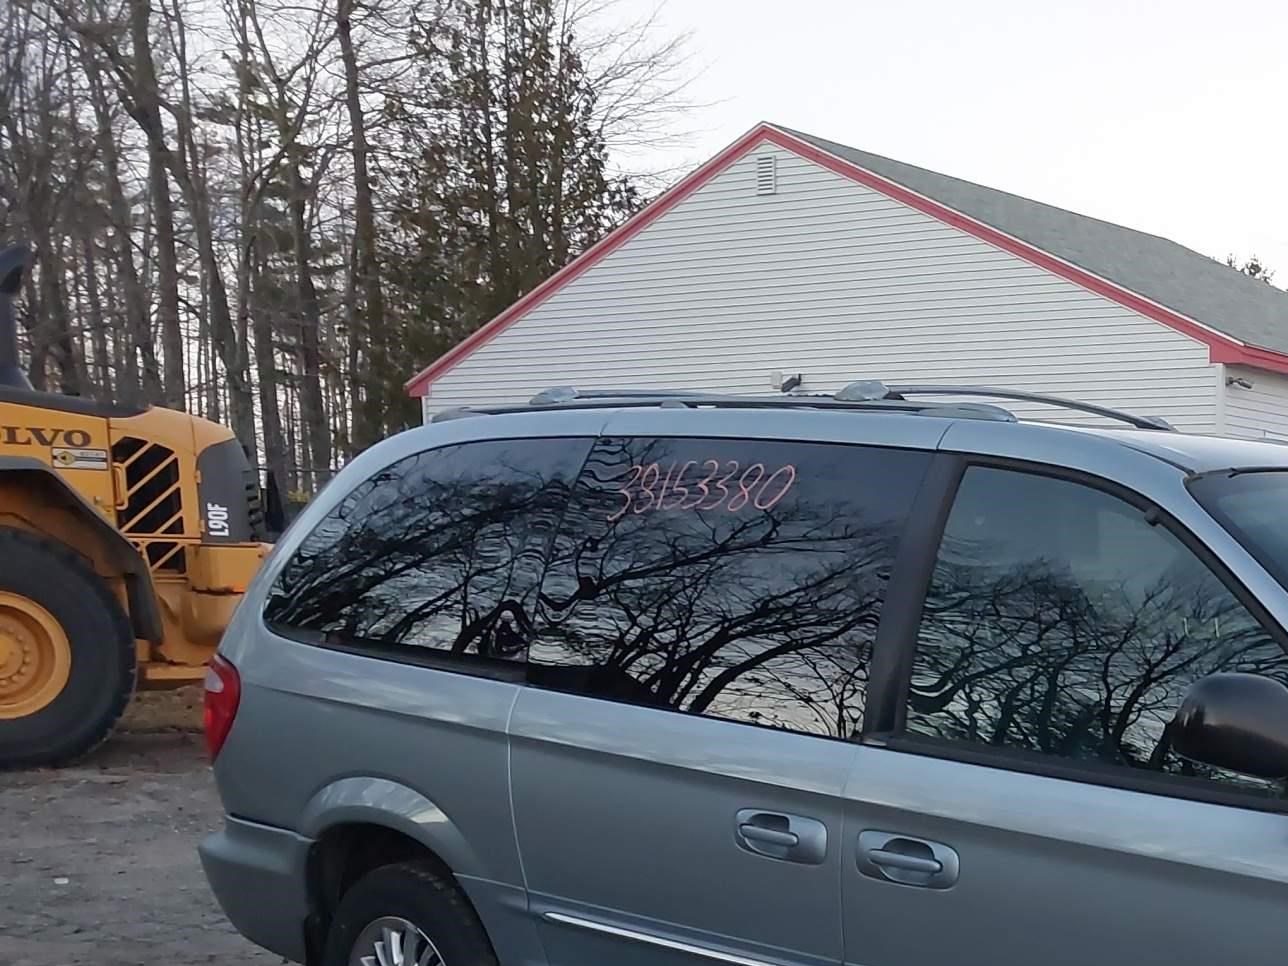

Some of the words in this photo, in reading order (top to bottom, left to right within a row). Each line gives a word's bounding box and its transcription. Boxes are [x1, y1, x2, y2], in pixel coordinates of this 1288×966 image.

[0, 426, 91, 448] LVO
[607, 459, 796, 522] 38153380
[207, 502, 230, 537] L90F
